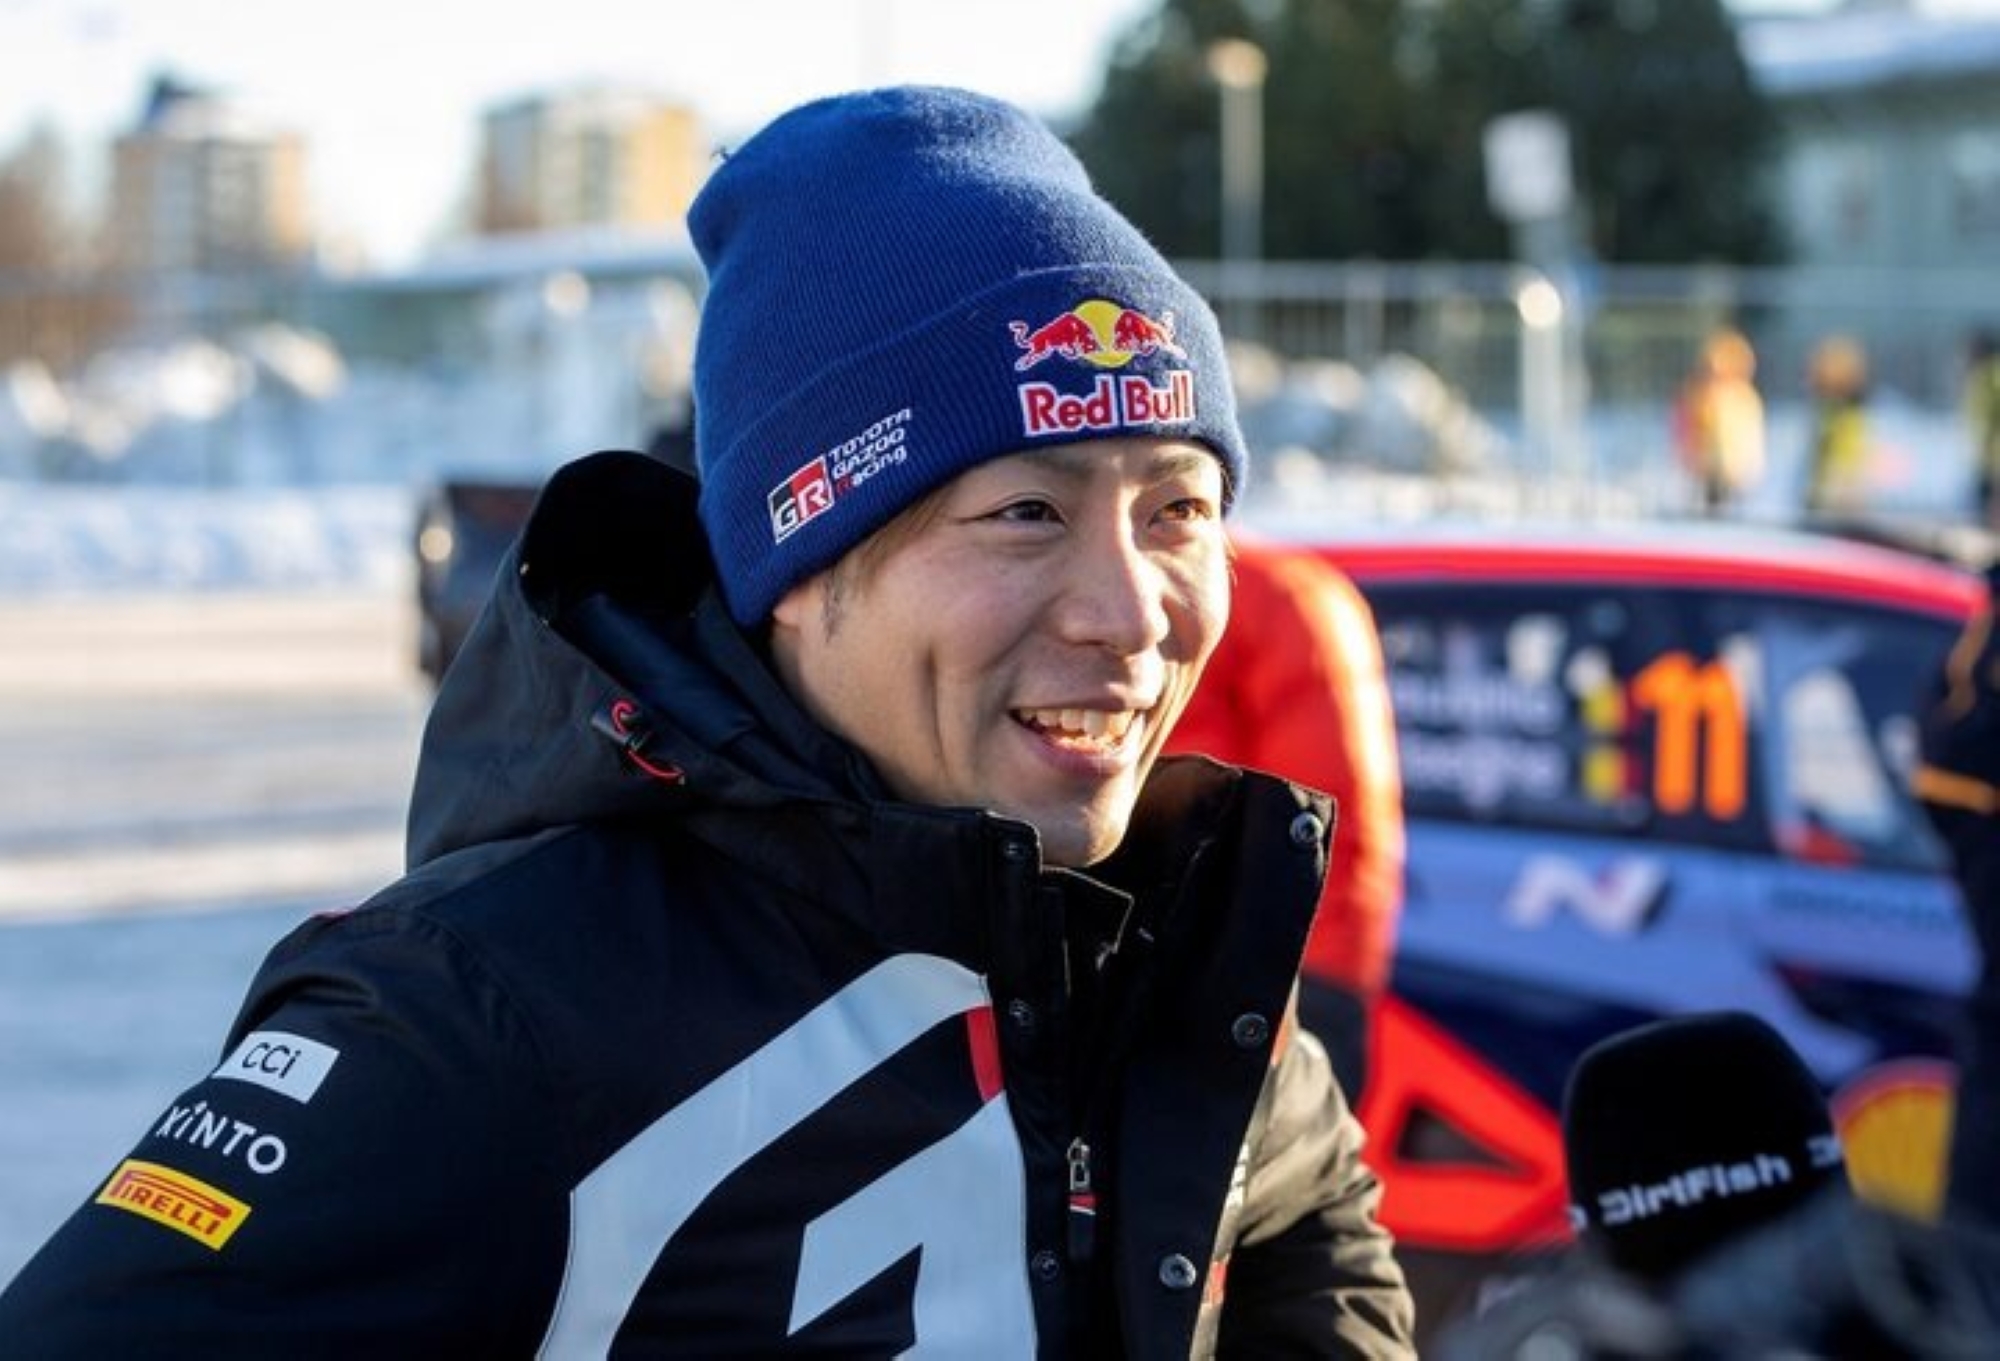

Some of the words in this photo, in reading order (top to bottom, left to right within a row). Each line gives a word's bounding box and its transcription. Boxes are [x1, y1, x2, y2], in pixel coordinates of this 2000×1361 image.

[828, 408, 911, 462] TOYOTA
[1018, 374, 1118, 437] Red
[1119, 370, 1195, 426] Bull
[832, 427, 905, 479] GAZOO
[774, 479, 828, 532] GR
[1634, 651, 1746, 820] 11
[108, 1170, 232, 1236] PIRELLI
[1599, 1154, 1792, 1225] DirtFish
